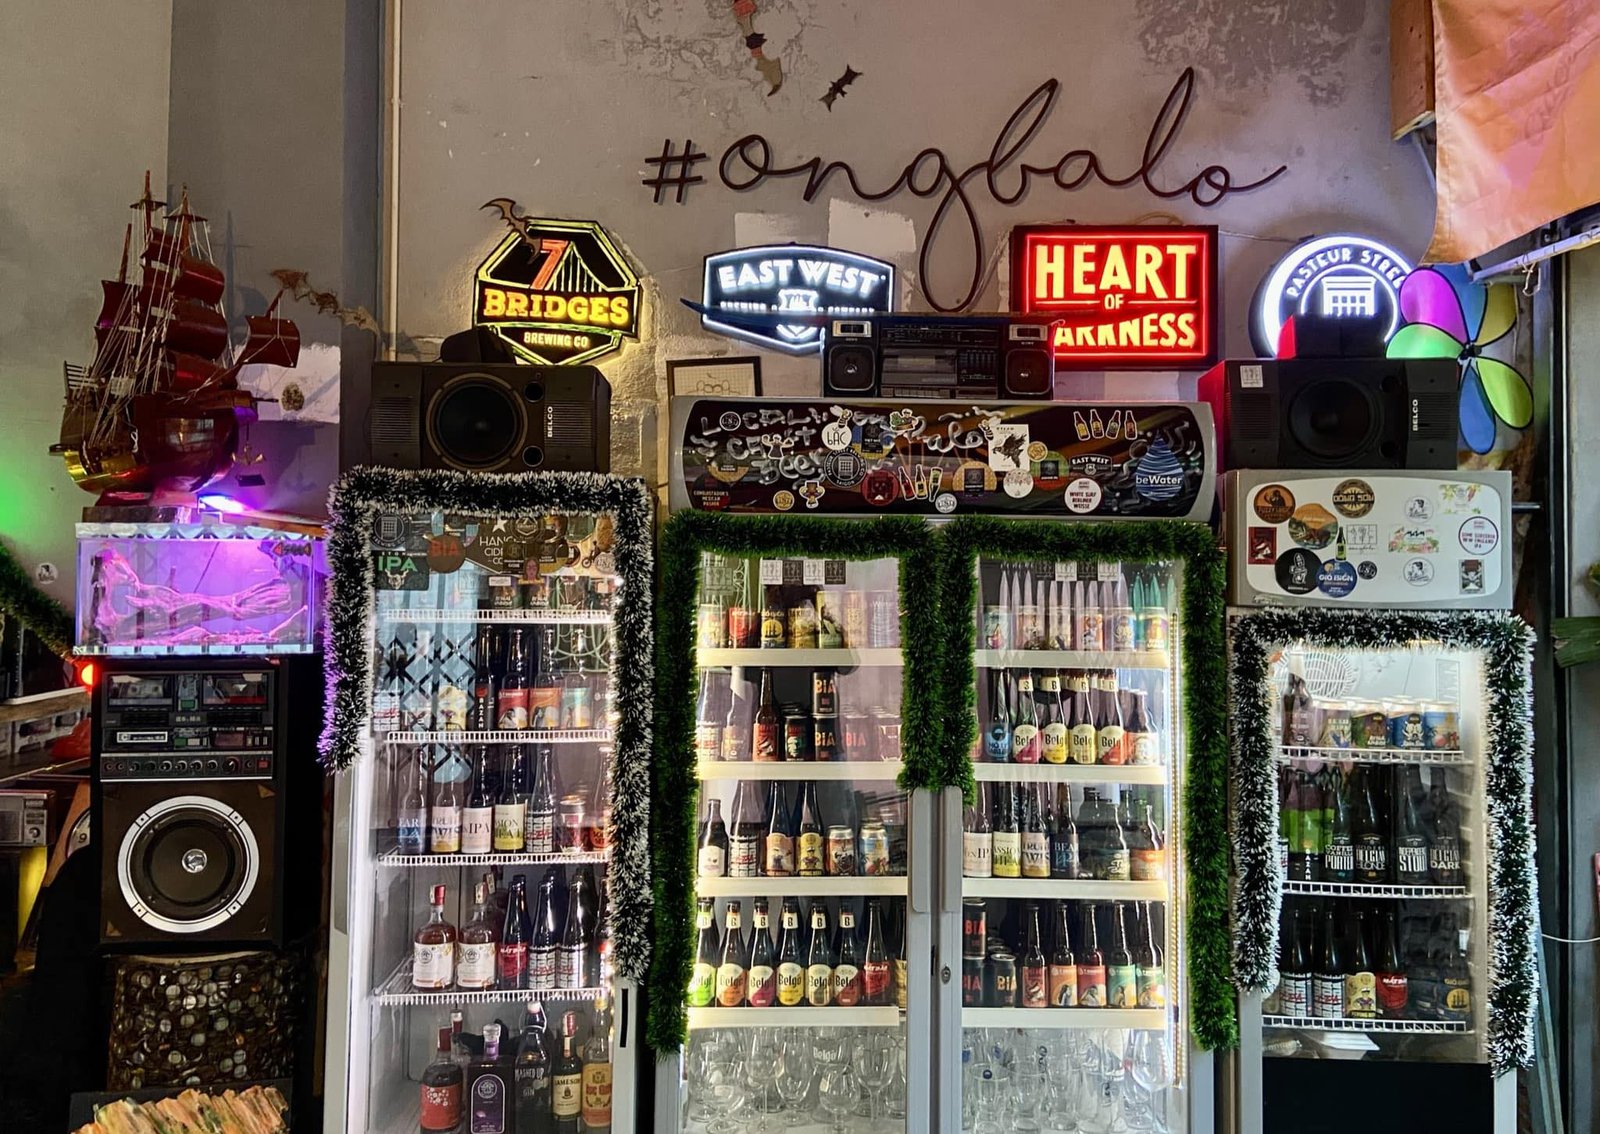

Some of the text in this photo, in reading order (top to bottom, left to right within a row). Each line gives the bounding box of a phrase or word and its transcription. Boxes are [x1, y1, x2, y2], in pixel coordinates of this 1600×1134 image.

[644, 66, 1288, 312] #ongbalo
[531, 238, 568, 290] 7
[1035, 244, 1197, 299] HEART
[718, 259, 880, 298] EAST WEST
[1286, 247, 1352, 298] PASTEUR
[484, 288, 630, 325] BRIDGES
[1104, 293, 1124, 310] OF
[1053, 312, 1197, 349] ARKNESS
[523, 331, 589, 348] BREWING CO
[546, 405, 554, 438] BELCO
[1411, 398, 1420, 432] BELCO
[1072, 456, 1109, 465] EAST WEST
[1136, 475, 1182, 485] beWater
[431, 541, 459, 556] BIA
[378, 556, 418, 572] IPA
[815, 679, 836, 694] BIA
[815, 732, 836, 747] BIA
[845, 732, 866, 747] BIA
[78, 832, 88, 844] 9
[1430, 861, 1461, 870] DARK
[964, 919, 986, 936] BIA
[997, 975, 1017, 991] BIA
[514, 1067, 545, 1082] MASHED UP
[522, 1086, 535, 1096] GIN
